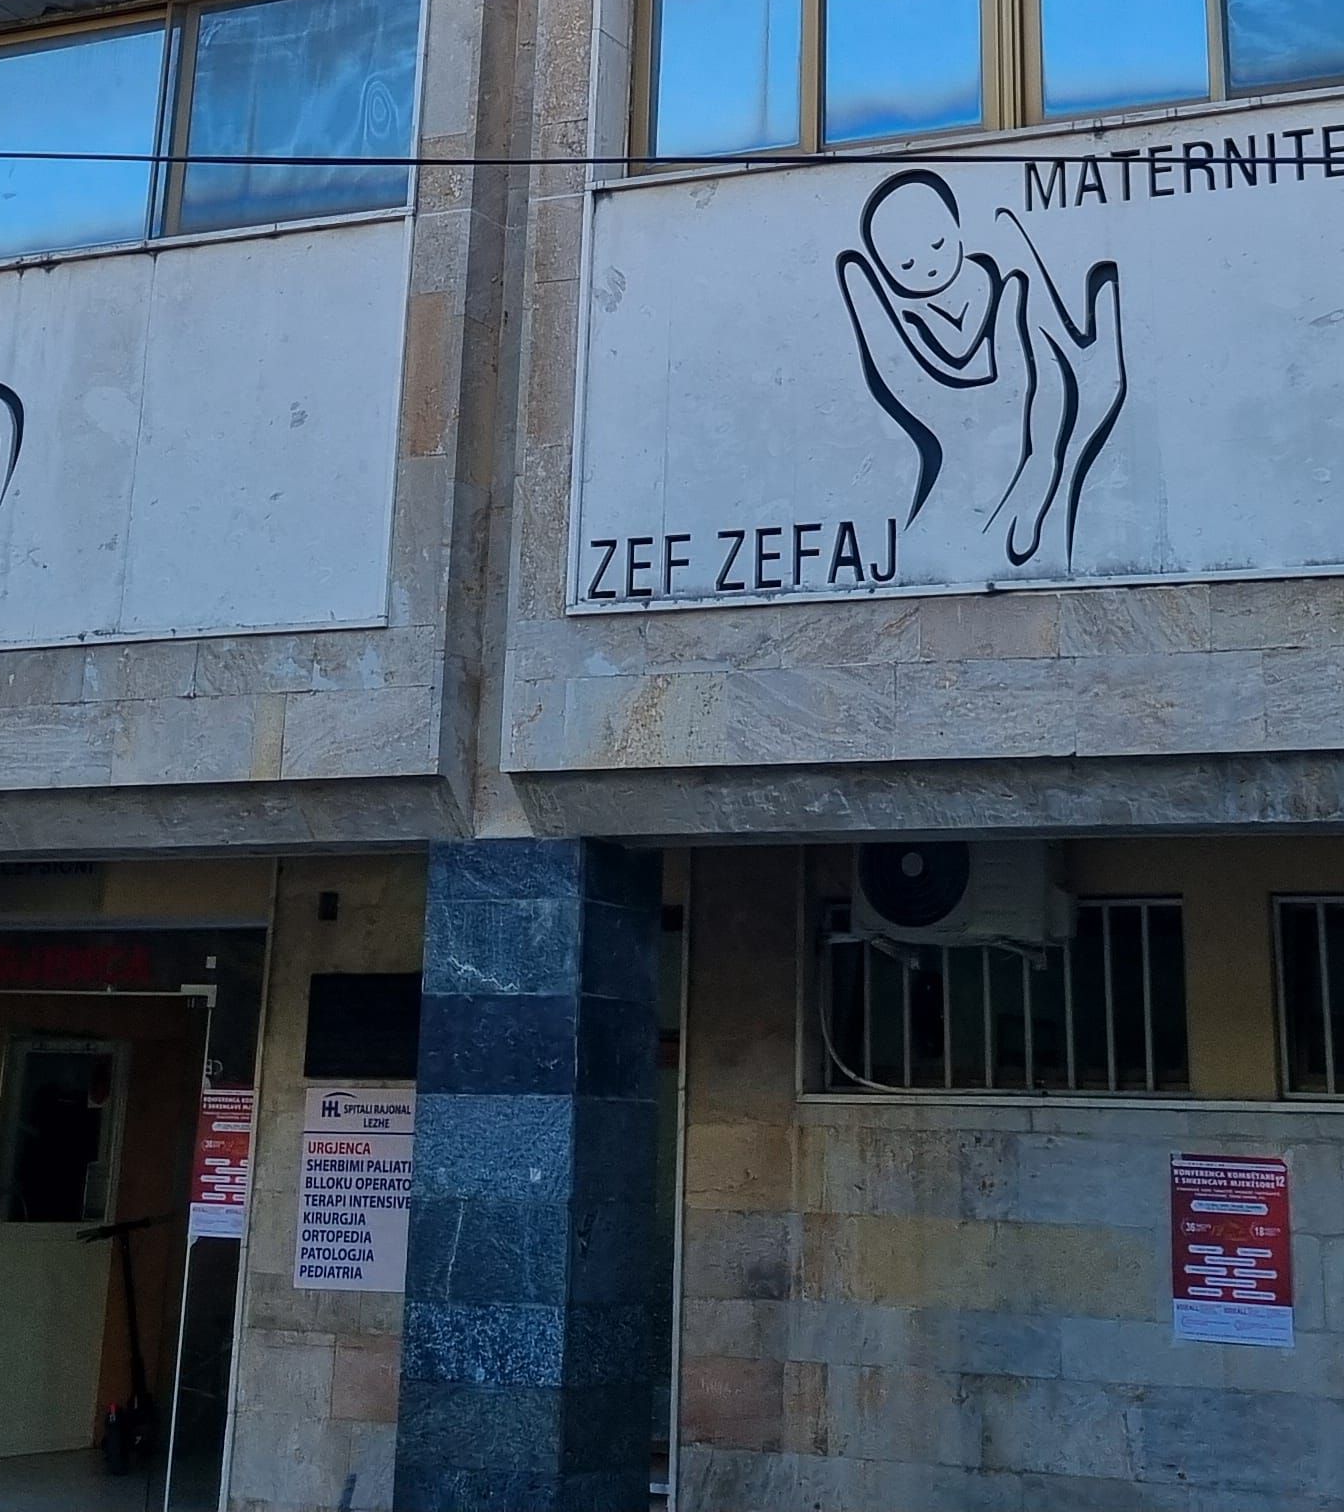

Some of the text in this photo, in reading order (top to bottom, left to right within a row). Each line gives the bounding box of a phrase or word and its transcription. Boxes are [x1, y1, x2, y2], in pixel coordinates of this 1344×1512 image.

[587, 518, 897, 599] ZEF ZEFAJ
[343, 1103, 411, 1115] SPITALI RAJONAL
[363, 1117, 390, 1129] LEZHE
[308, 1141, 371, 1155] URGJENCA
[306, 1159, 364, 1172] SHERBIMI
[305, 1176, 353, 1189] BLLOKU
[304, 1194, 412, 1209] TERAPI INTENSIVE
[303, 1211, 366, 1225] KIRURGJIA
[302, 1229, 372, 1243] ORTOPEDIA
[300, 1247, 374, 1262] PATOLOGJIA
[299, 1264, 363, 1279] PEDIATRIA
